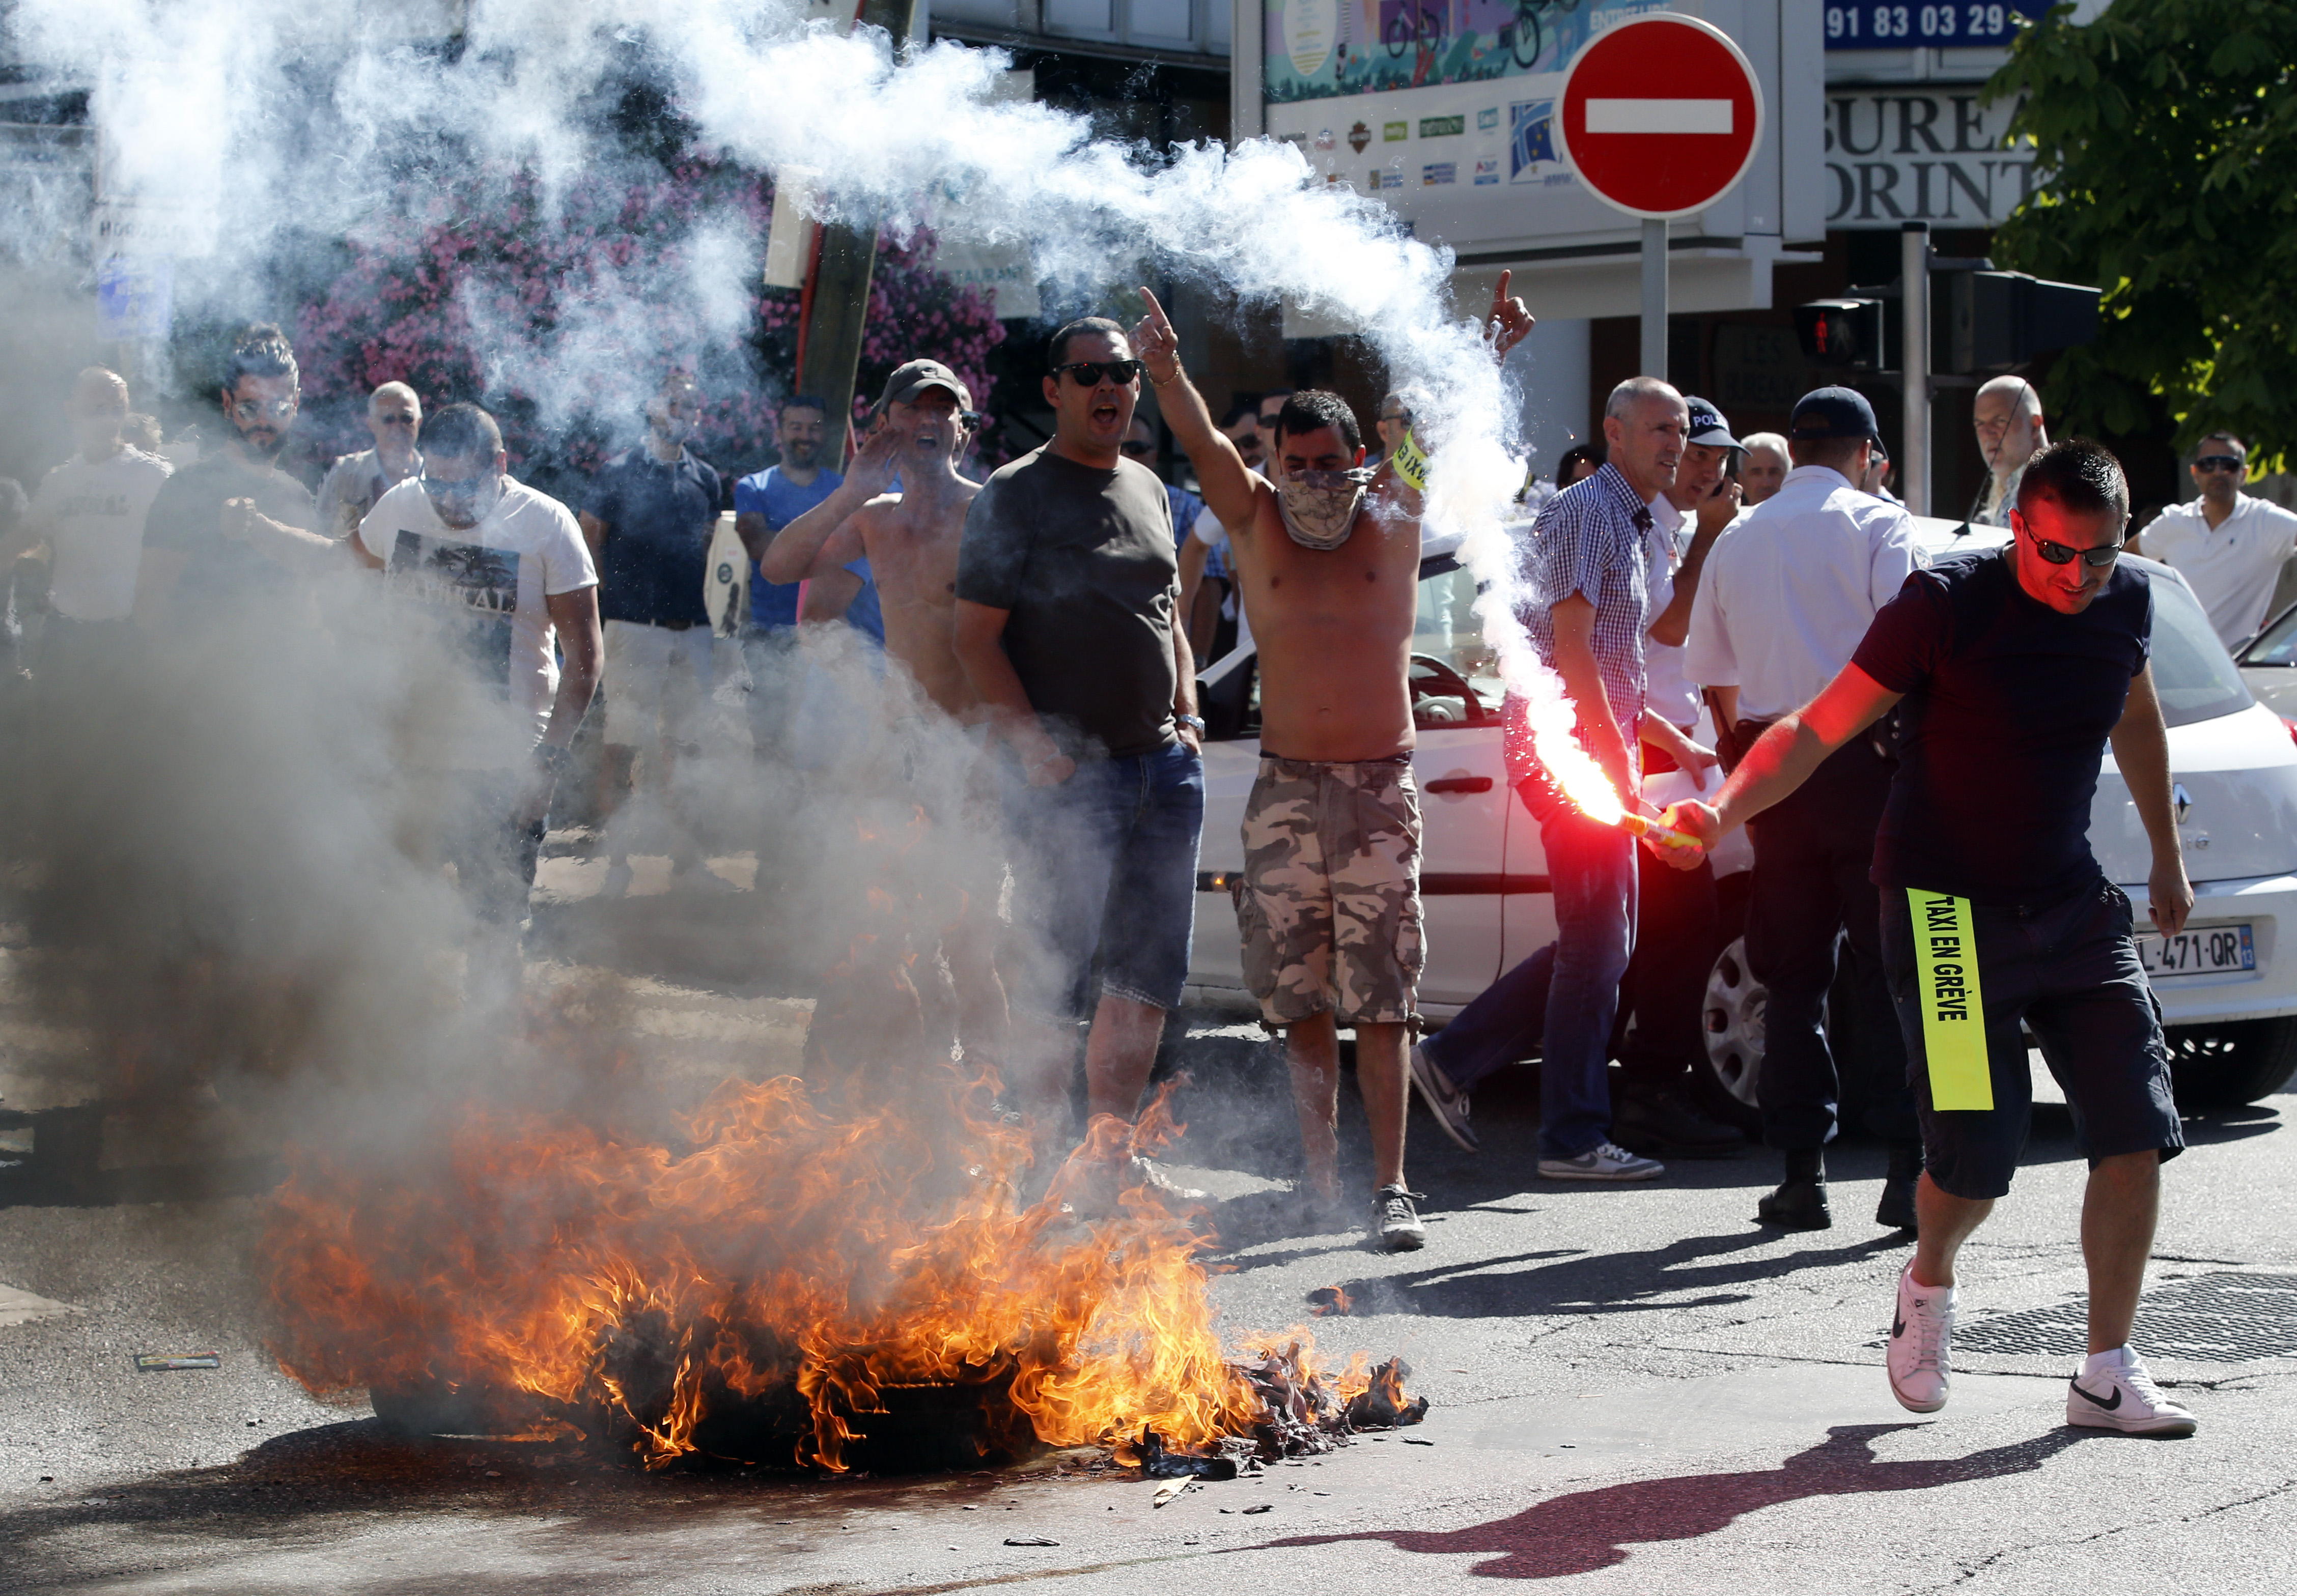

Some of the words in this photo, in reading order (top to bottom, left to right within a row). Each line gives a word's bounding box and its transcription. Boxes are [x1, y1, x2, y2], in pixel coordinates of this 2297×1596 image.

[1827, 7, 1859, 38] 91
[1873, 6, 1909, 37] 83
[1920, 5, 1956, 37] 03
[1967, 4, 2004, 36] 29
[1925, 896, 1958, 931] TAXI
[1930, 936, 1962, 958] EN
[1933, 963, 1973, 1021] GRÈVE
